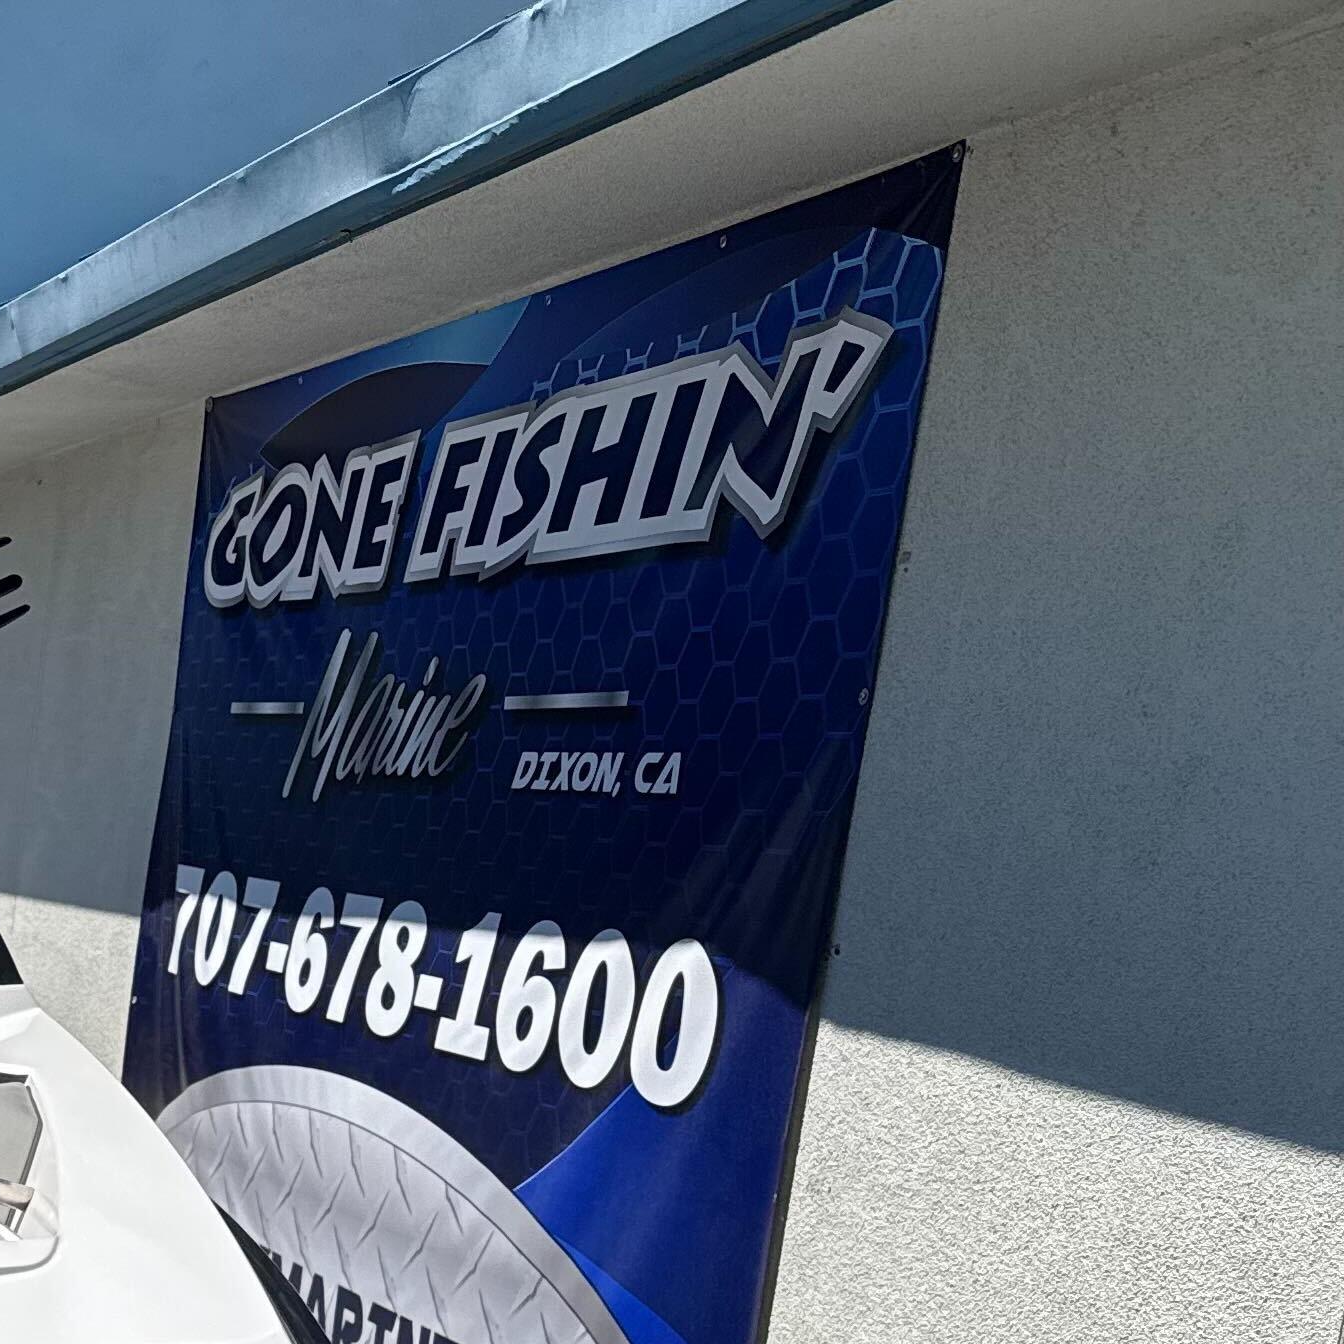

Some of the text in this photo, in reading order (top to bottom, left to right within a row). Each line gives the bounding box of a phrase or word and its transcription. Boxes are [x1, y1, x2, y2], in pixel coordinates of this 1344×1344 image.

[206, 312, 892, 607] GONE FISHIN'
[281, 628, 486, 802] Marine
[511, 751, 682, 797] DIXON, CA
[167, 864, 718, 1107] 707-678-1600
